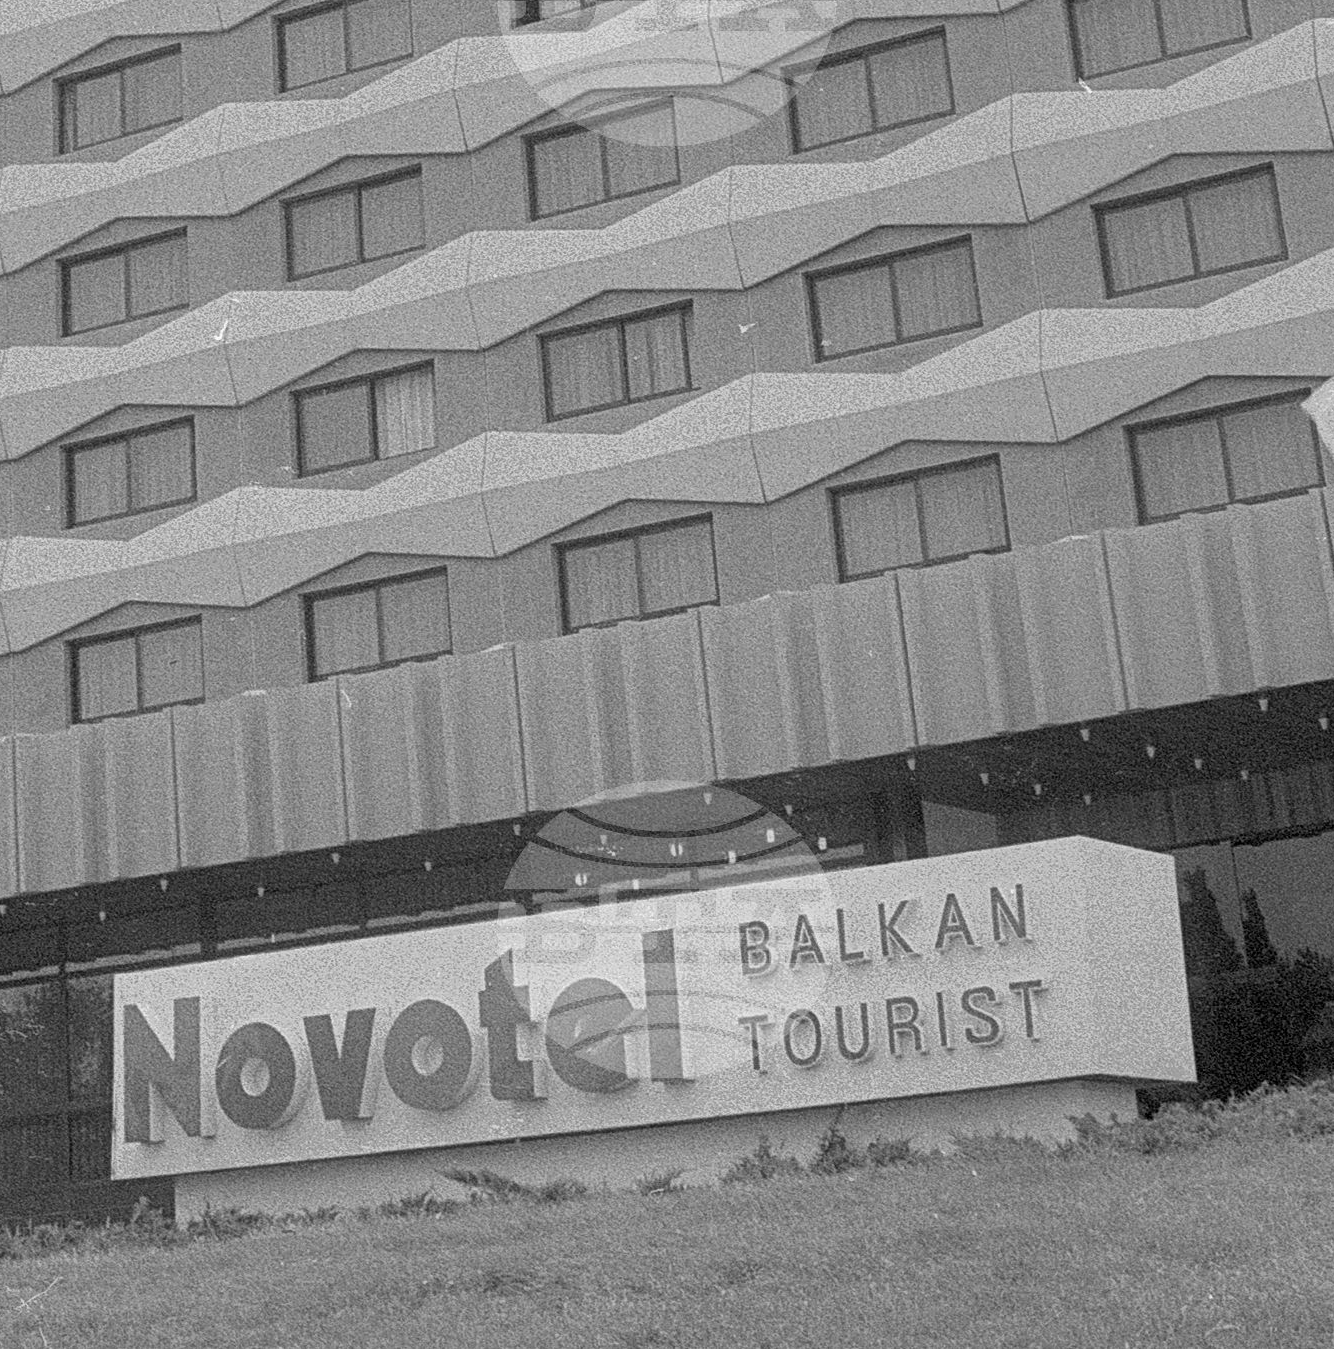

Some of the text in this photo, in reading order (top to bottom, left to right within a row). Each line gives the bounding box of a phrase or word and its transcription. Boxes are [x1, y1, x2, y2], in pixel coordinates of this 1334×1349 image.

[738, 884, 1031, 977] BALKAN
[123, 927, 693, 1143] Novotel
[737, 978, 1046, 1071] TOURIST
